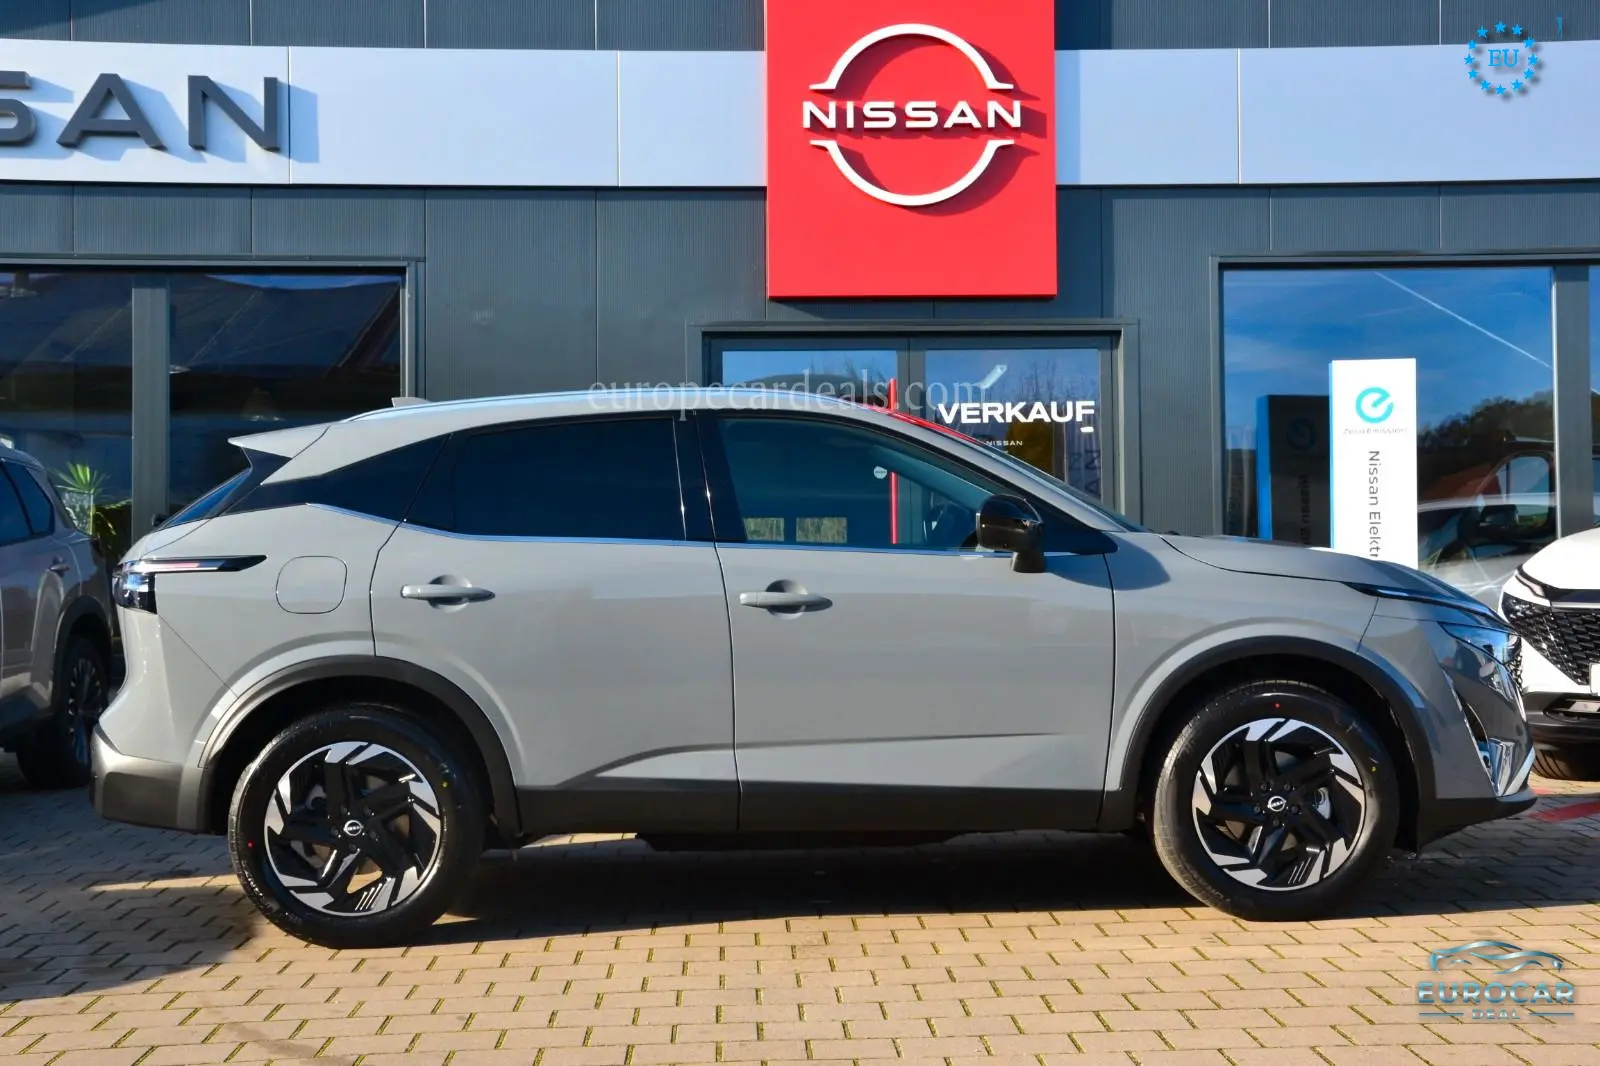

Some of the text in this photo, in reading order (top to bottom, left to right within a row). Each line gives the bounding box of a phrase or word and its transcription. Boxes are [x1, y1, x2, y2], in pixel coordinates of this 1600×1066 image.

[802, 100, 1022, 129] NISSAN
[938, 401, 1095, 424] VERKAUF
[1368, 450, 1382, 506] Nissan
